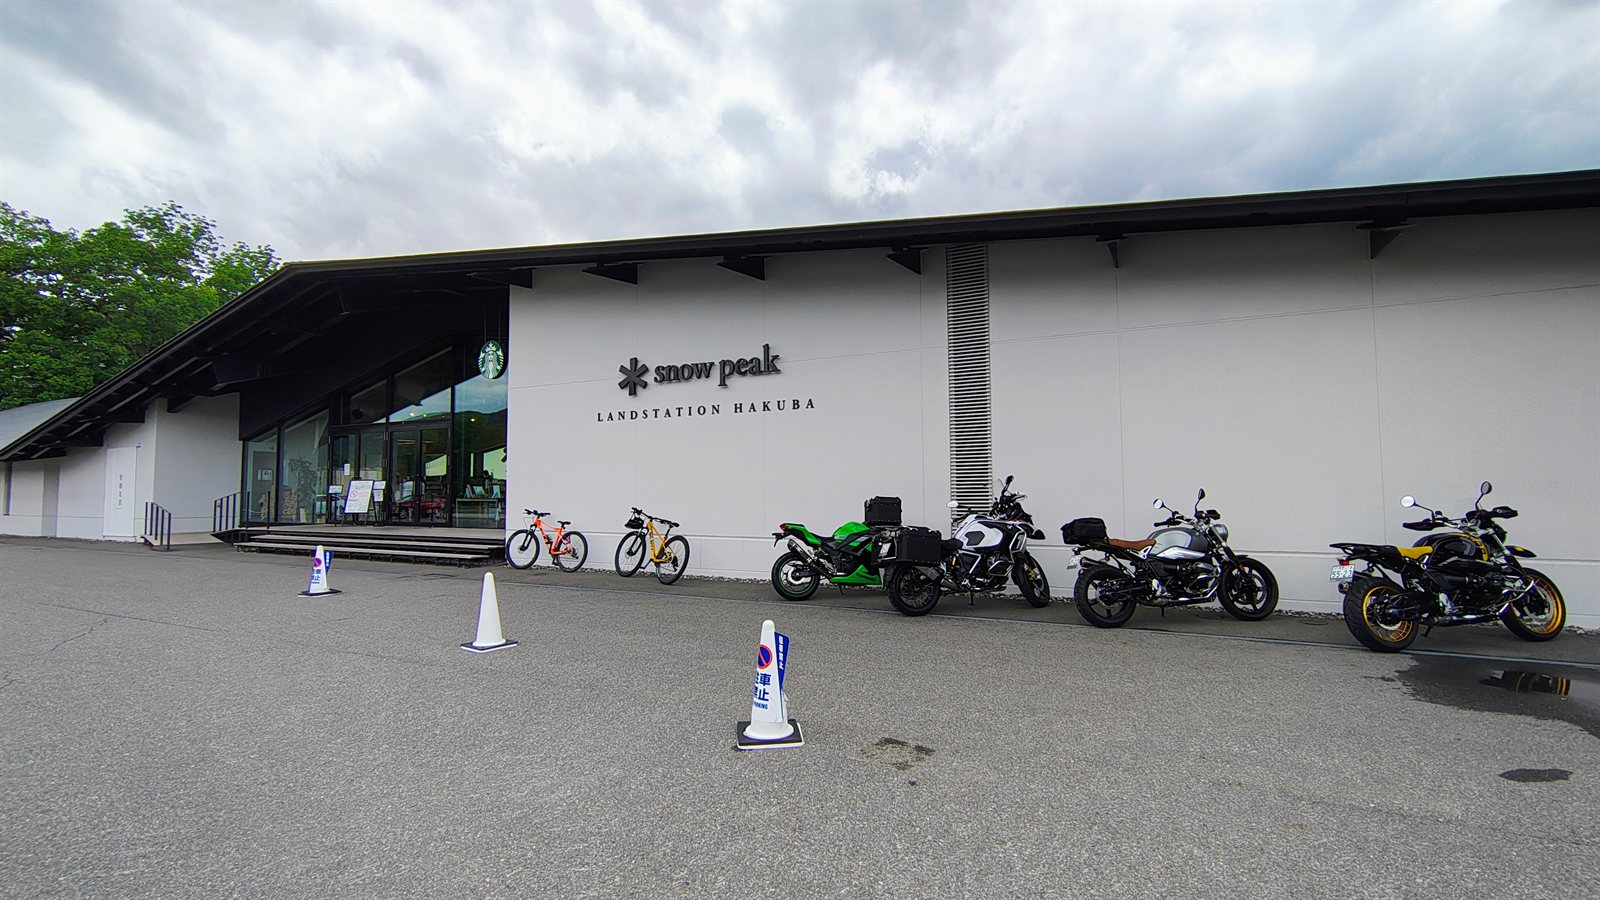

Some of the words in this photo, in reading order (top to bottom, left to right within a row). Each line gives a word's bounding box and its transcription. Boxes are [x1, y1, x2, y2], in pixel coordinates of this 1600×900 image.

[653, 361, 715, 384] snow
[718, 344, 782, 387] peak
[597, 404, 720, 422] LANDSTATION
[734, 398, 816, 414] HAKUBA
